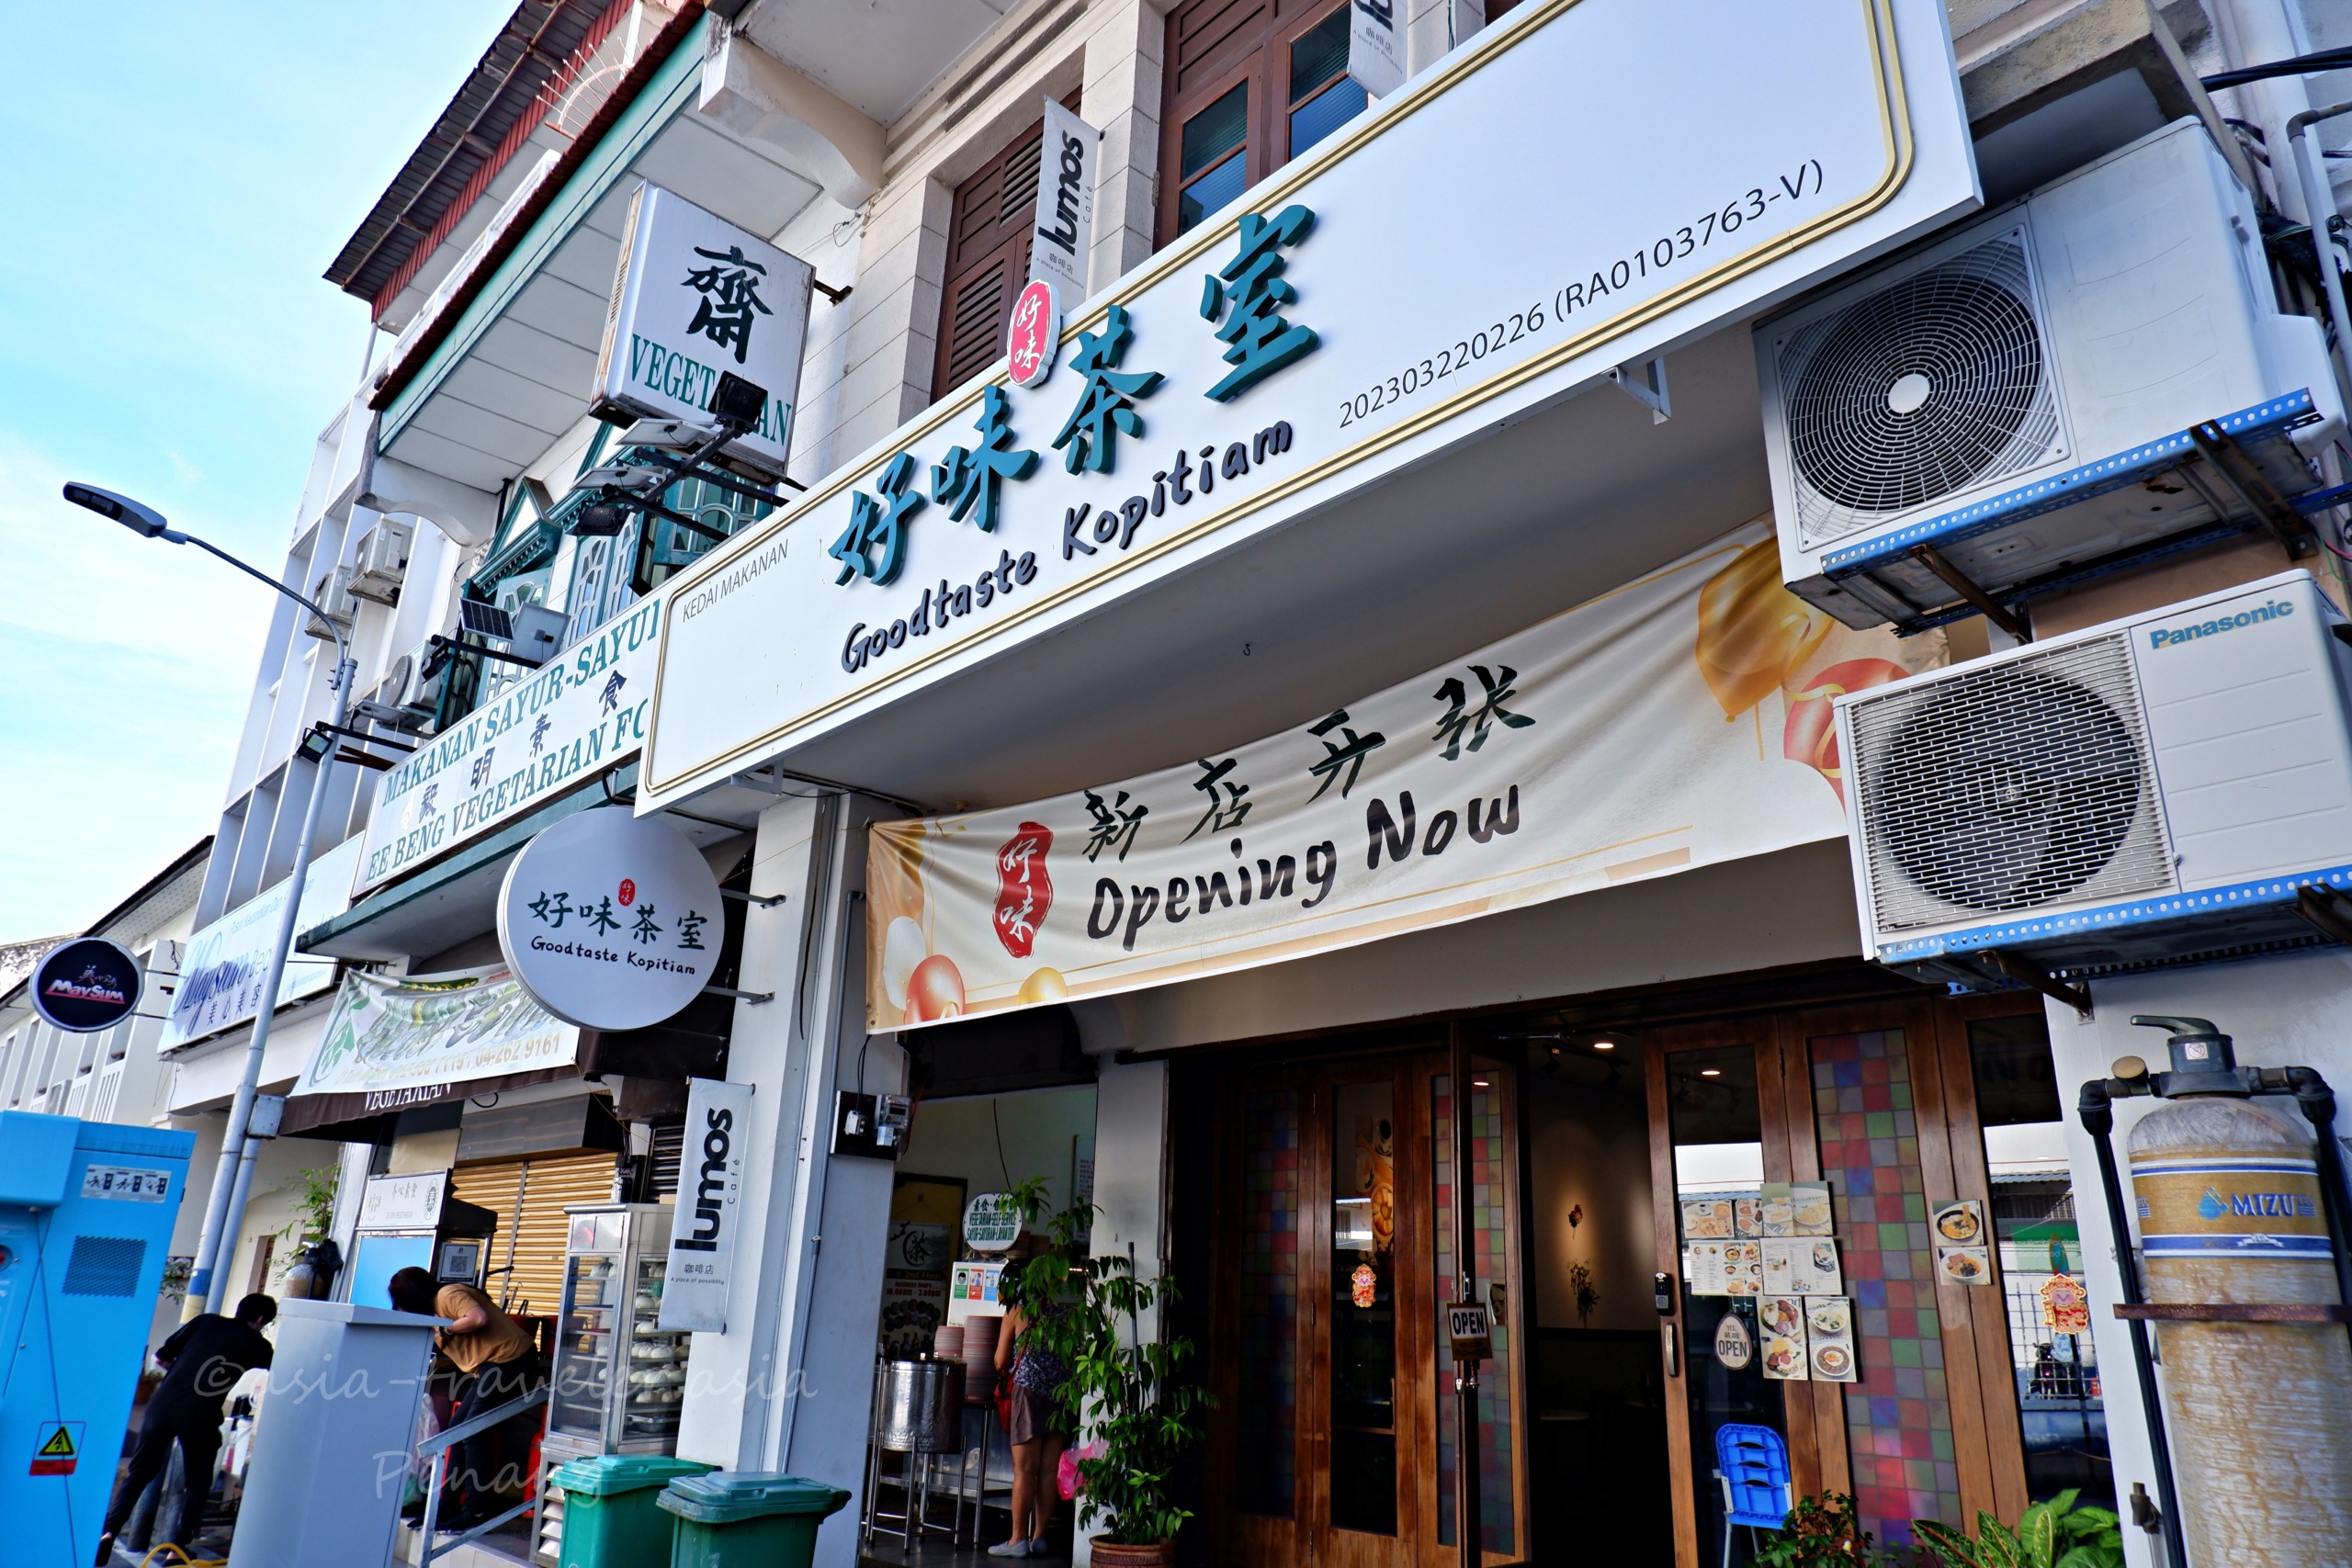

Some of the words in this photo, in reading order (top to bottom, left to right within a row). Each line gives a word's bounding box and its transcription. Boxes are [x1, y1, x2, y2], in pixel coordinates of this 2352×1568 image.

[1038, 130, 1084, 257] lumos
[1048, 253, 1074, 275] 咖啡店
[1339, 302, 1545, 429] 202303220226
[1555, 159, 1824, 322] (RA0103763-V)
[1013, 292, 1043, 369] 好味
[631, 333, 791, 447] VEGETAN
[828, 204, 1321, 588] 好味茶室
[682, 588, 718, 624] KEDAI
[721, 538, 789, 597] MAKANAN
[842, 548, 1038, 673] Goodtaste
[1062, 420, 1293, 560] Kopitiam
[2149, 600, 2294, 649] Panasonic
[366, 842, 391, 884] EE
[392, 817, 446, 874] BENG
[451, 722, 607, 835] VEGETARIAN
[382, 719, 482, 807] MAKANAN
[1082, 664, 1536, 864] 新店开张
[1001, 838, 1037, 944] 好味
[1087, 838, 1337, 952] Opening
[1366, 784, 1521, 871] Now
[527, 890, 707, 951] 好味茶室
[531, 935, 618, 963] Goodtaste
[628, 951, 695, 976] Kopitiam
[44, 978, 126, 1004] MaySum
[674, 1107, 733, 1252] lumos
[727, 1158, 741, 1205] Café
[2232, 1193, 2295, 1216] MIZU
[684, 1263, 715, 1275] 咖啡店
[1453, 1312, 1486, 1335] OPEN
[1718, 1339, 1747, 1358] OPEN
